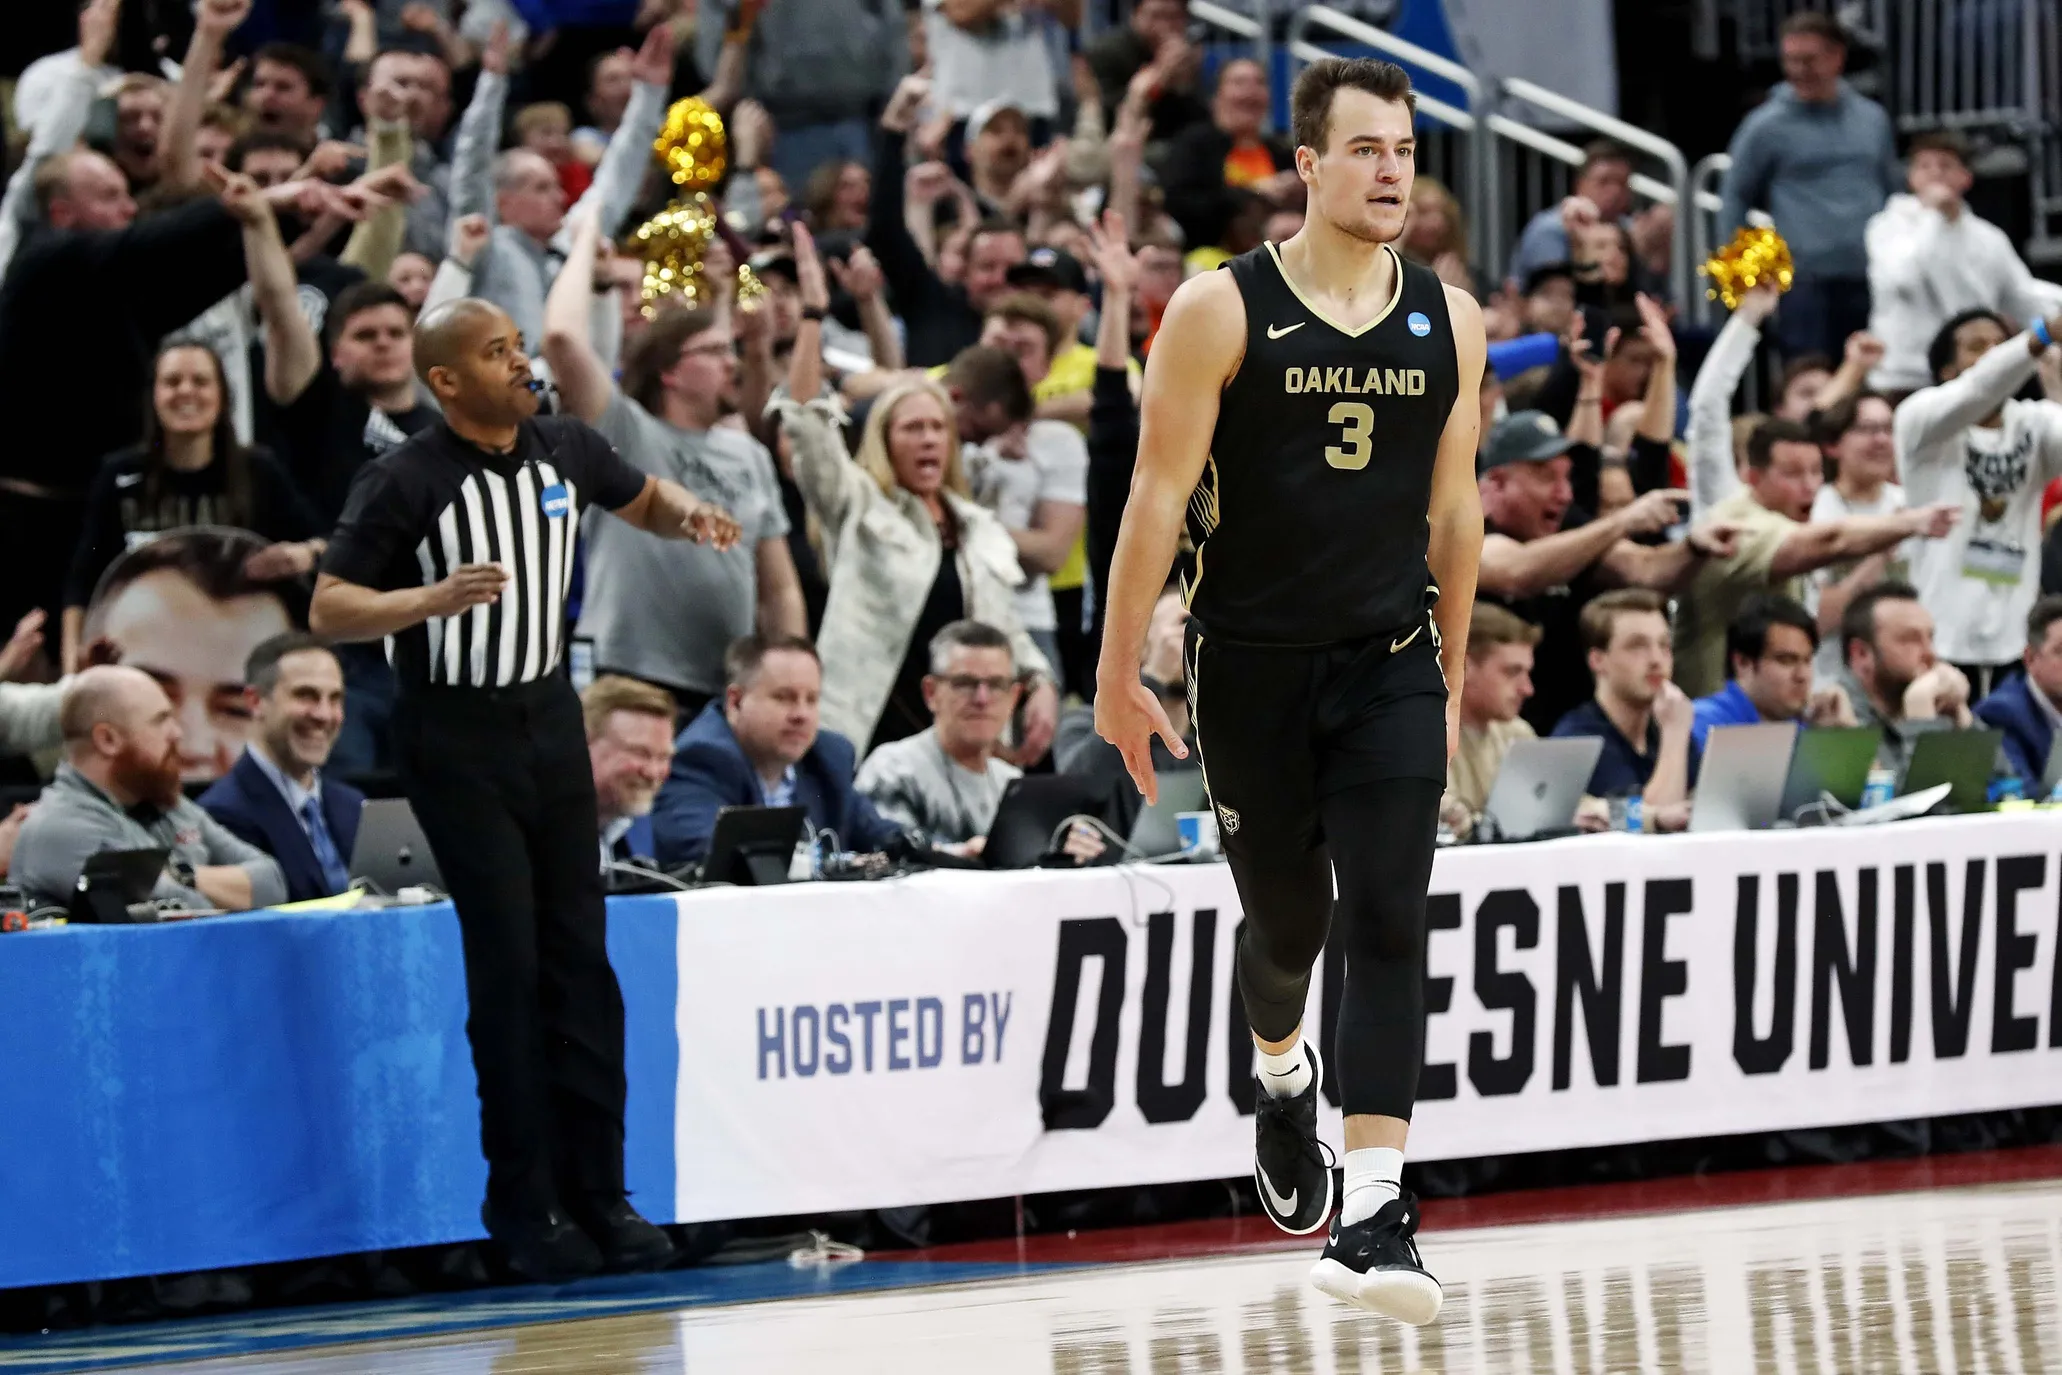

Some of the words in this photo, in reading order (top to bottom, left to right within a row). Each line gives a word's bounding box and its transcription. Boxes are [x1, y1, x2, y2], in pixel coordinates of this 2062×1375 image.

[1285, 366, 1426, 396] OAKLAND
[1324, 401, 1375, 470] 3
[757, 997, 943, 1080] HOSTED
[961, 992, 1012, 1065] BY
[1039, 878, 1694, 1131] DUESNE
[1733, 853, 2062, 1075] UNIVE
